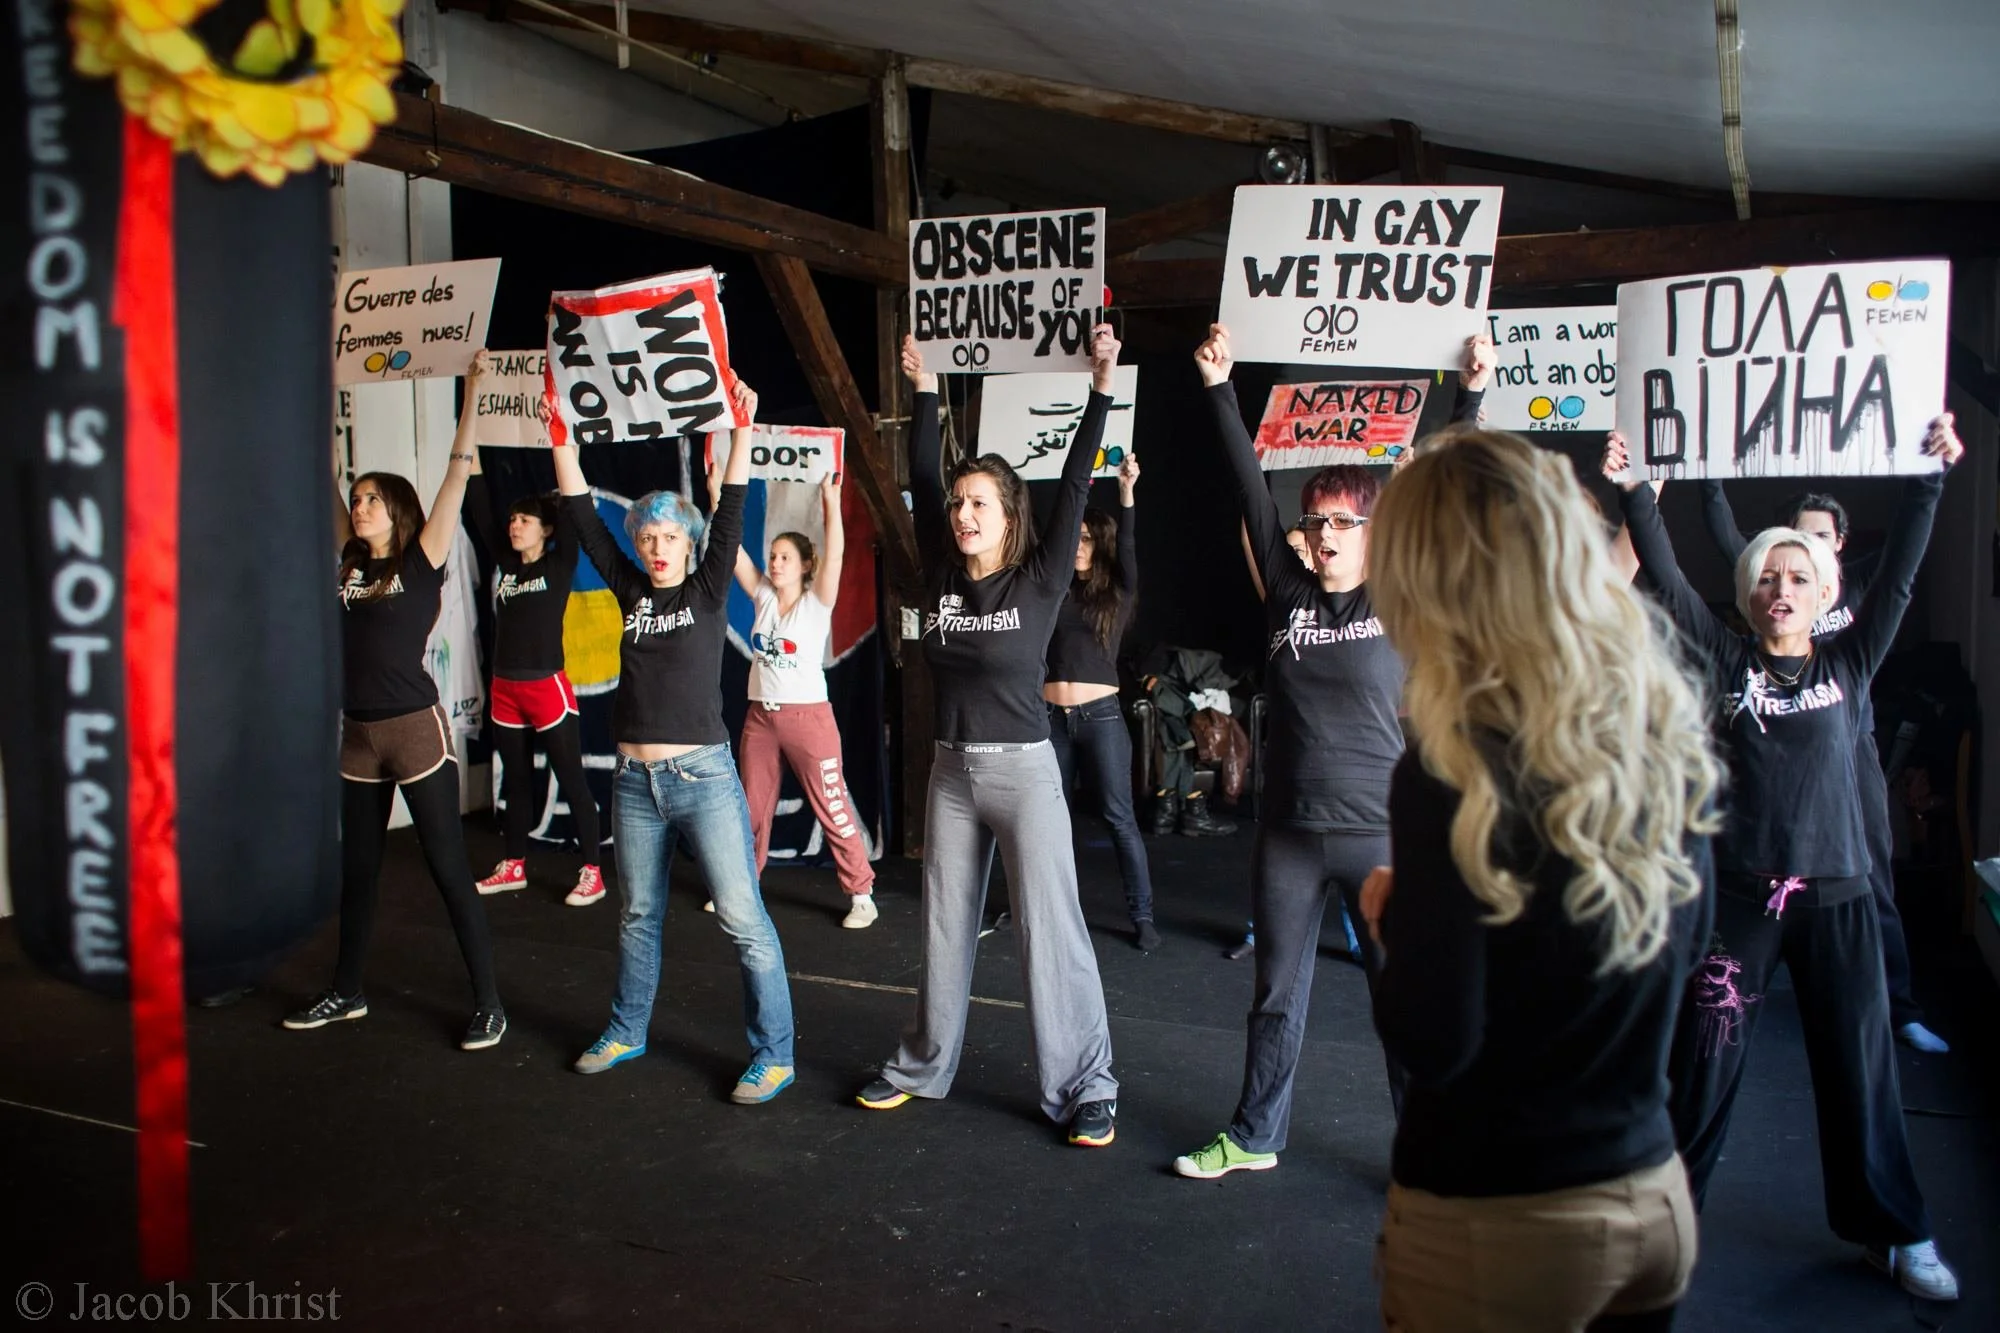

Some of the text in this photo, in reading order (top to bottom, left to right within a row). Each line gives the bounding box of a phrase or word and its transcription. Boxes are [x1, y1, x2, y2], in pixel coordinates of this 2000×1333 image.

[1306, 198, 1481, 247] IN GAY
[913, 212, 1096, 280] OBSCENE
[344, 275, 454, 313] Guerre des
[1243, 253, 1493, 309] WE TRUST
[915, 277, 1083, 341] BECAUSE OF
[1487, 315, 1502, 346] I
[1508, 324, 1541, 343] am
[1556, 323, 1570, 341] a
[1666, 272, 1854, 358] ГОЛА
[1866, 305, 1928, 325] FEMEN
[336, 311, 474, 361] femmes nues!
[1300, 338, 1357, 353] FEMEN
[489, 355, 546, 376] RANCE
[607, 350, 648, 397] IS
[1495, 348, 1538, 388] not
[1548, 363, 1576, 385] an
[1289, 383, 1422, 415] NAKED
[45, 407, 107, 465] IS
[1294, 418, 1368, 442] WAR
[1529, 420, 1580, 432] FEMEN
[751, 446, 821, 468] oor
[50, 496, 115, 696] NOT
[964, 744, 1004, 754] danza
[822, 757, 857, 840] HUDSON
[64, 711, 128, 972] FREE
